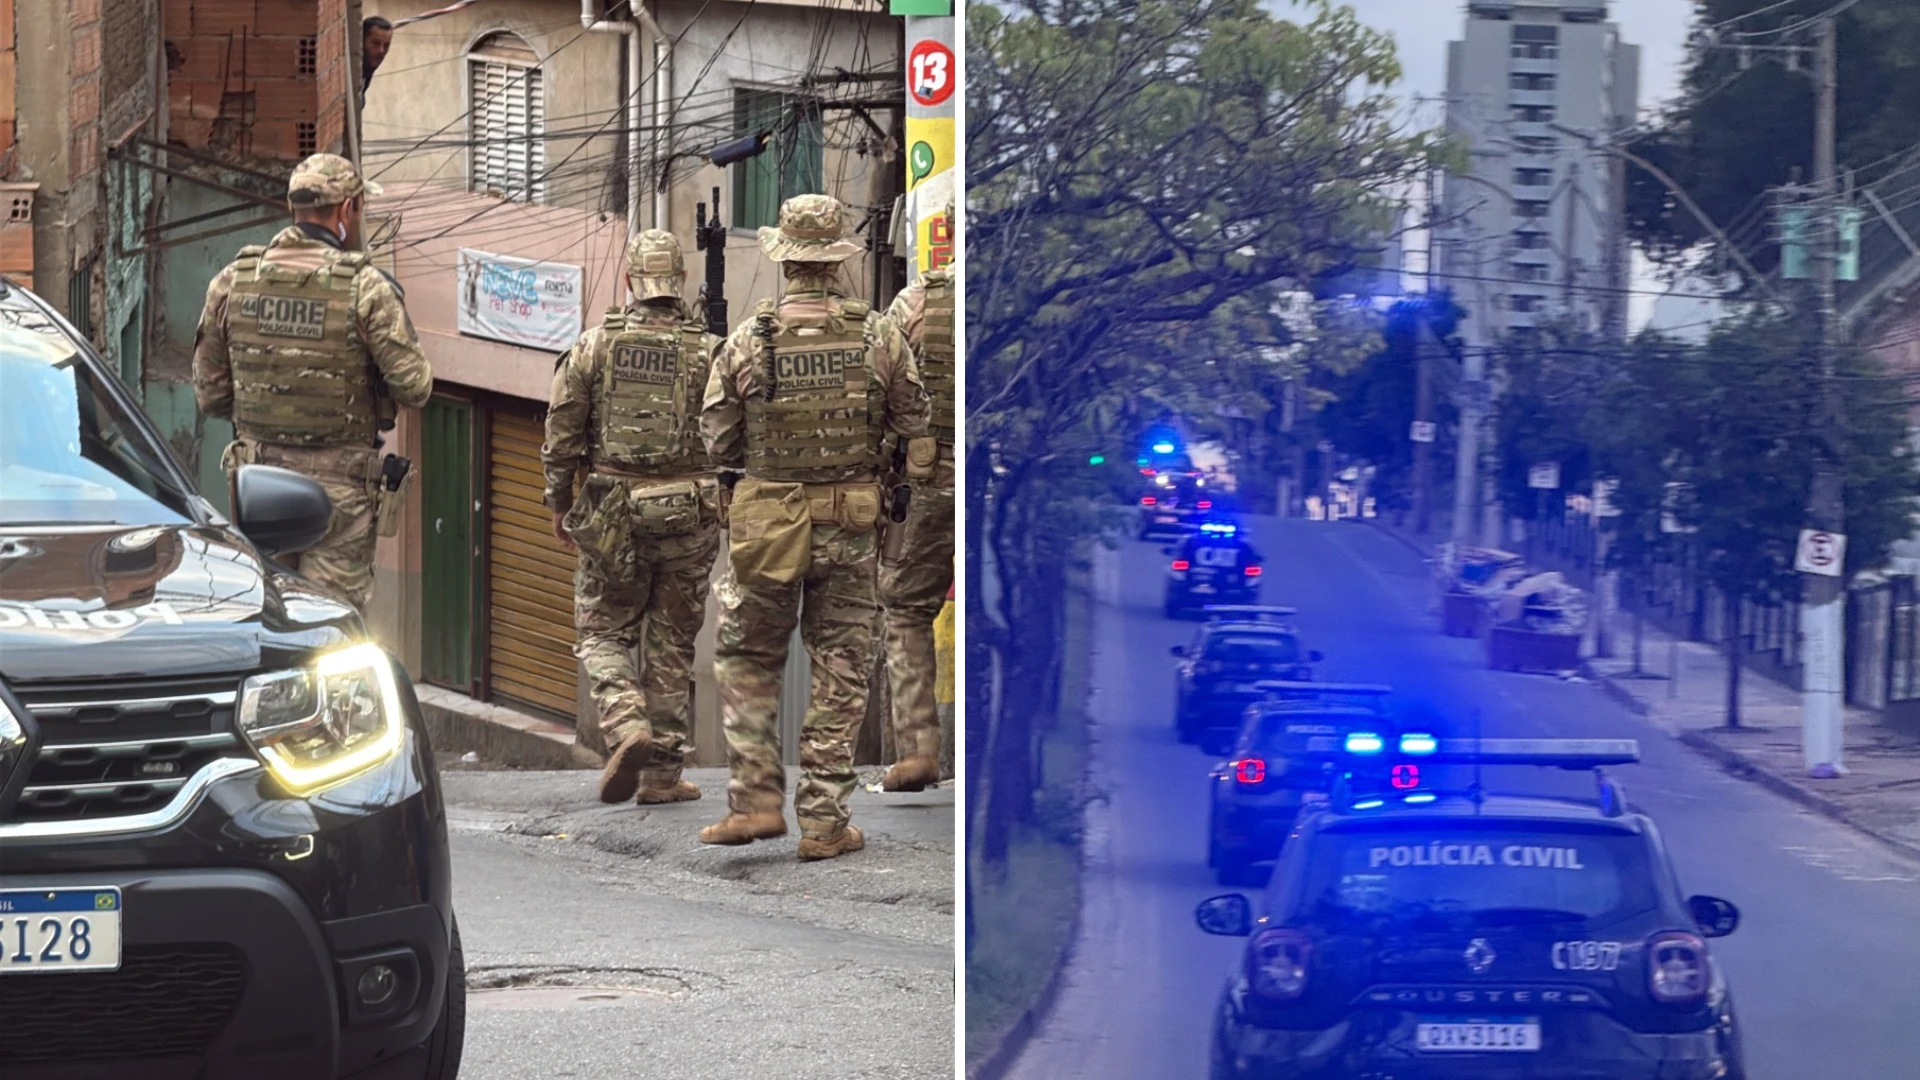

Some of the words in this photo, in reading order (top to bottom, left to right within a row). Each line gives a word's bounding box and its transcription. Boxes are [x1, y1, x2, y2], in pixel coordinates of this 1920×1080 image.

[913, 51, 948, 93] 13
[260, 297, 325, 325] CORE
[298, 325, 321, 336] CIVIL
[616, 347, 676, 372] CORE
[777, 352, 842, 378] CORE
[846, 351, 862, 365] 34
[651, 373, 672, 383] CIVIL
[818, 376, 844, 386] CIVIL
[1369, 840, 1495, 868] POLÍCIA
[1502, 845, 1585, 870] CIVIL
